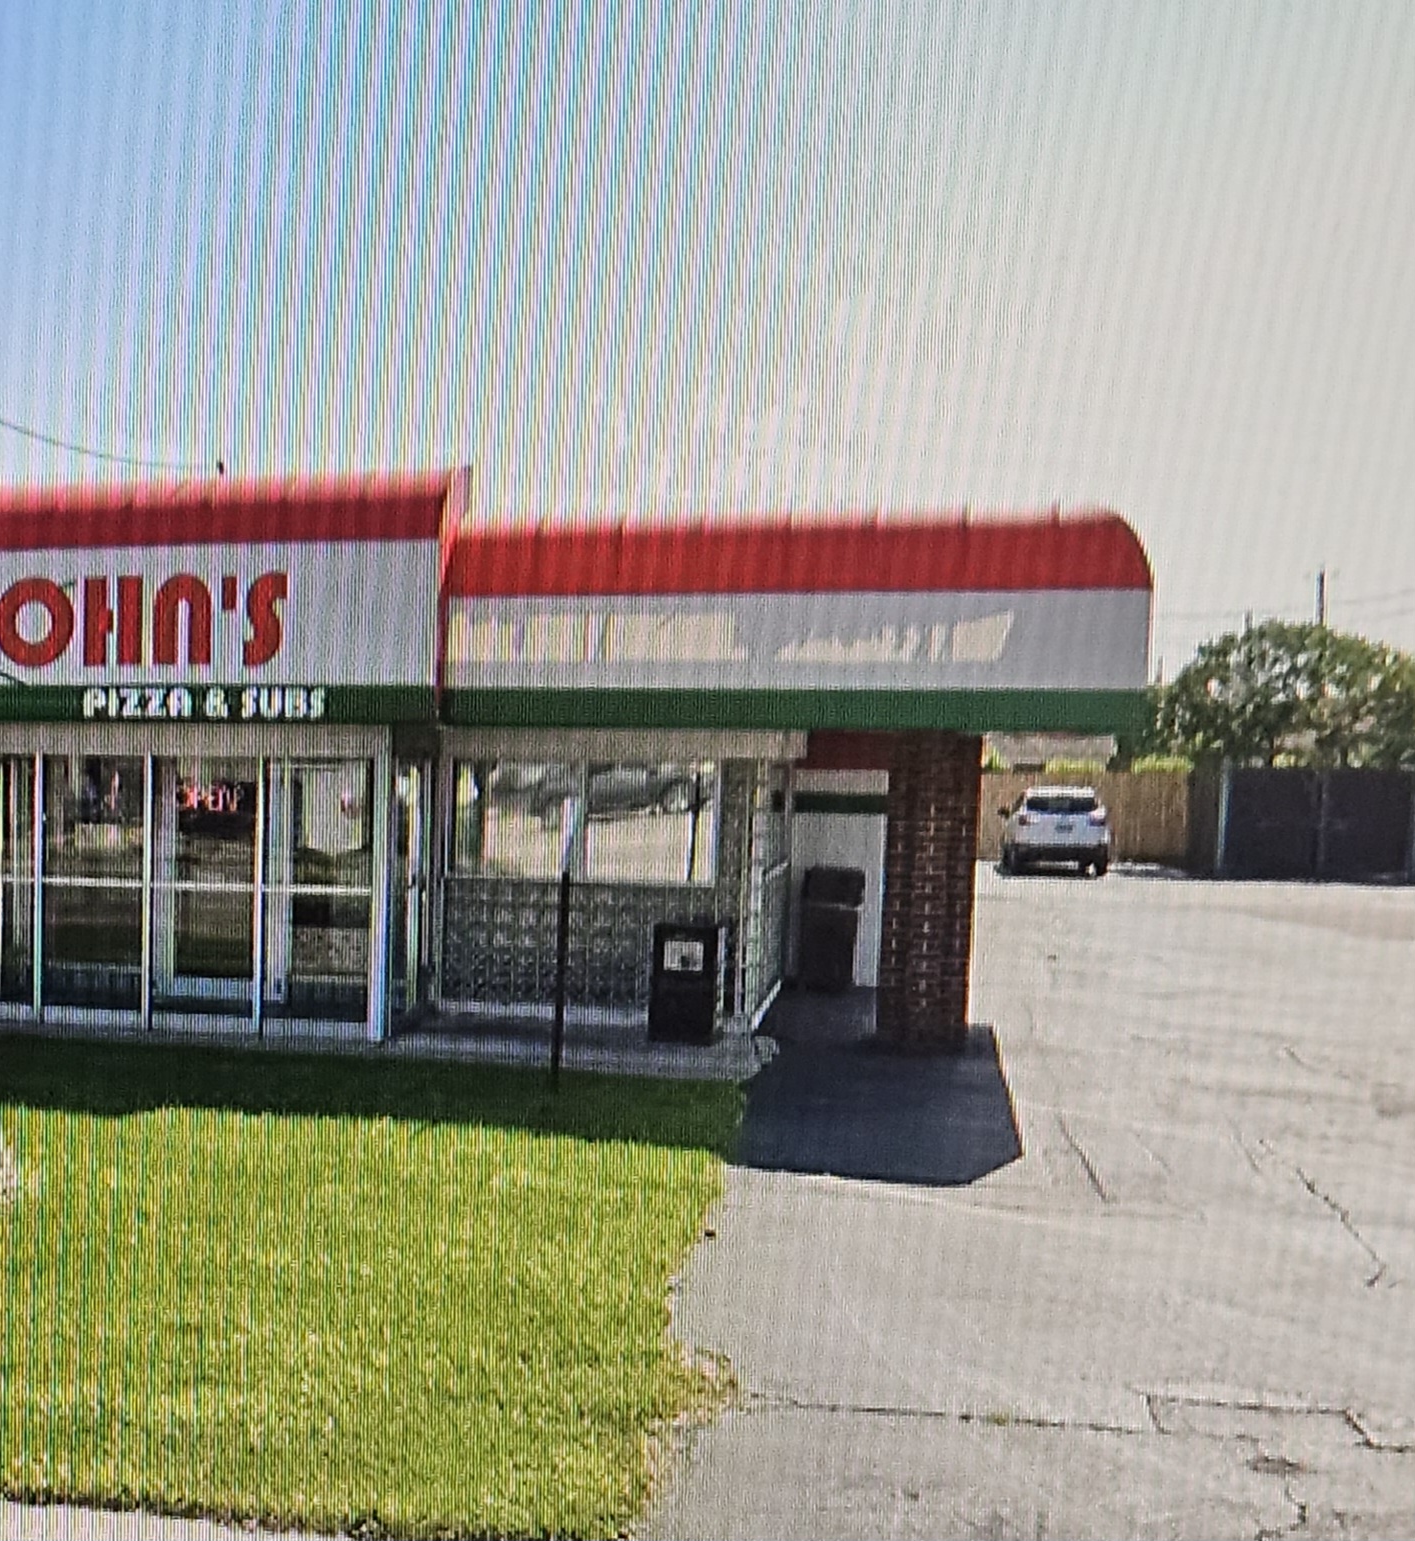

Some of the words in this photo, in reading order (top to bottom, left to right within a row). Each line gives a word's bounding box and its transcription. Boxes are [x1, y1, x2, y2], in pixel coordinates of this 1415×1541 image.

[83, 687, 192, 720] PIZZA
[205, 688, 227, 720] &
[241, 686, 326, 719] SUBS
